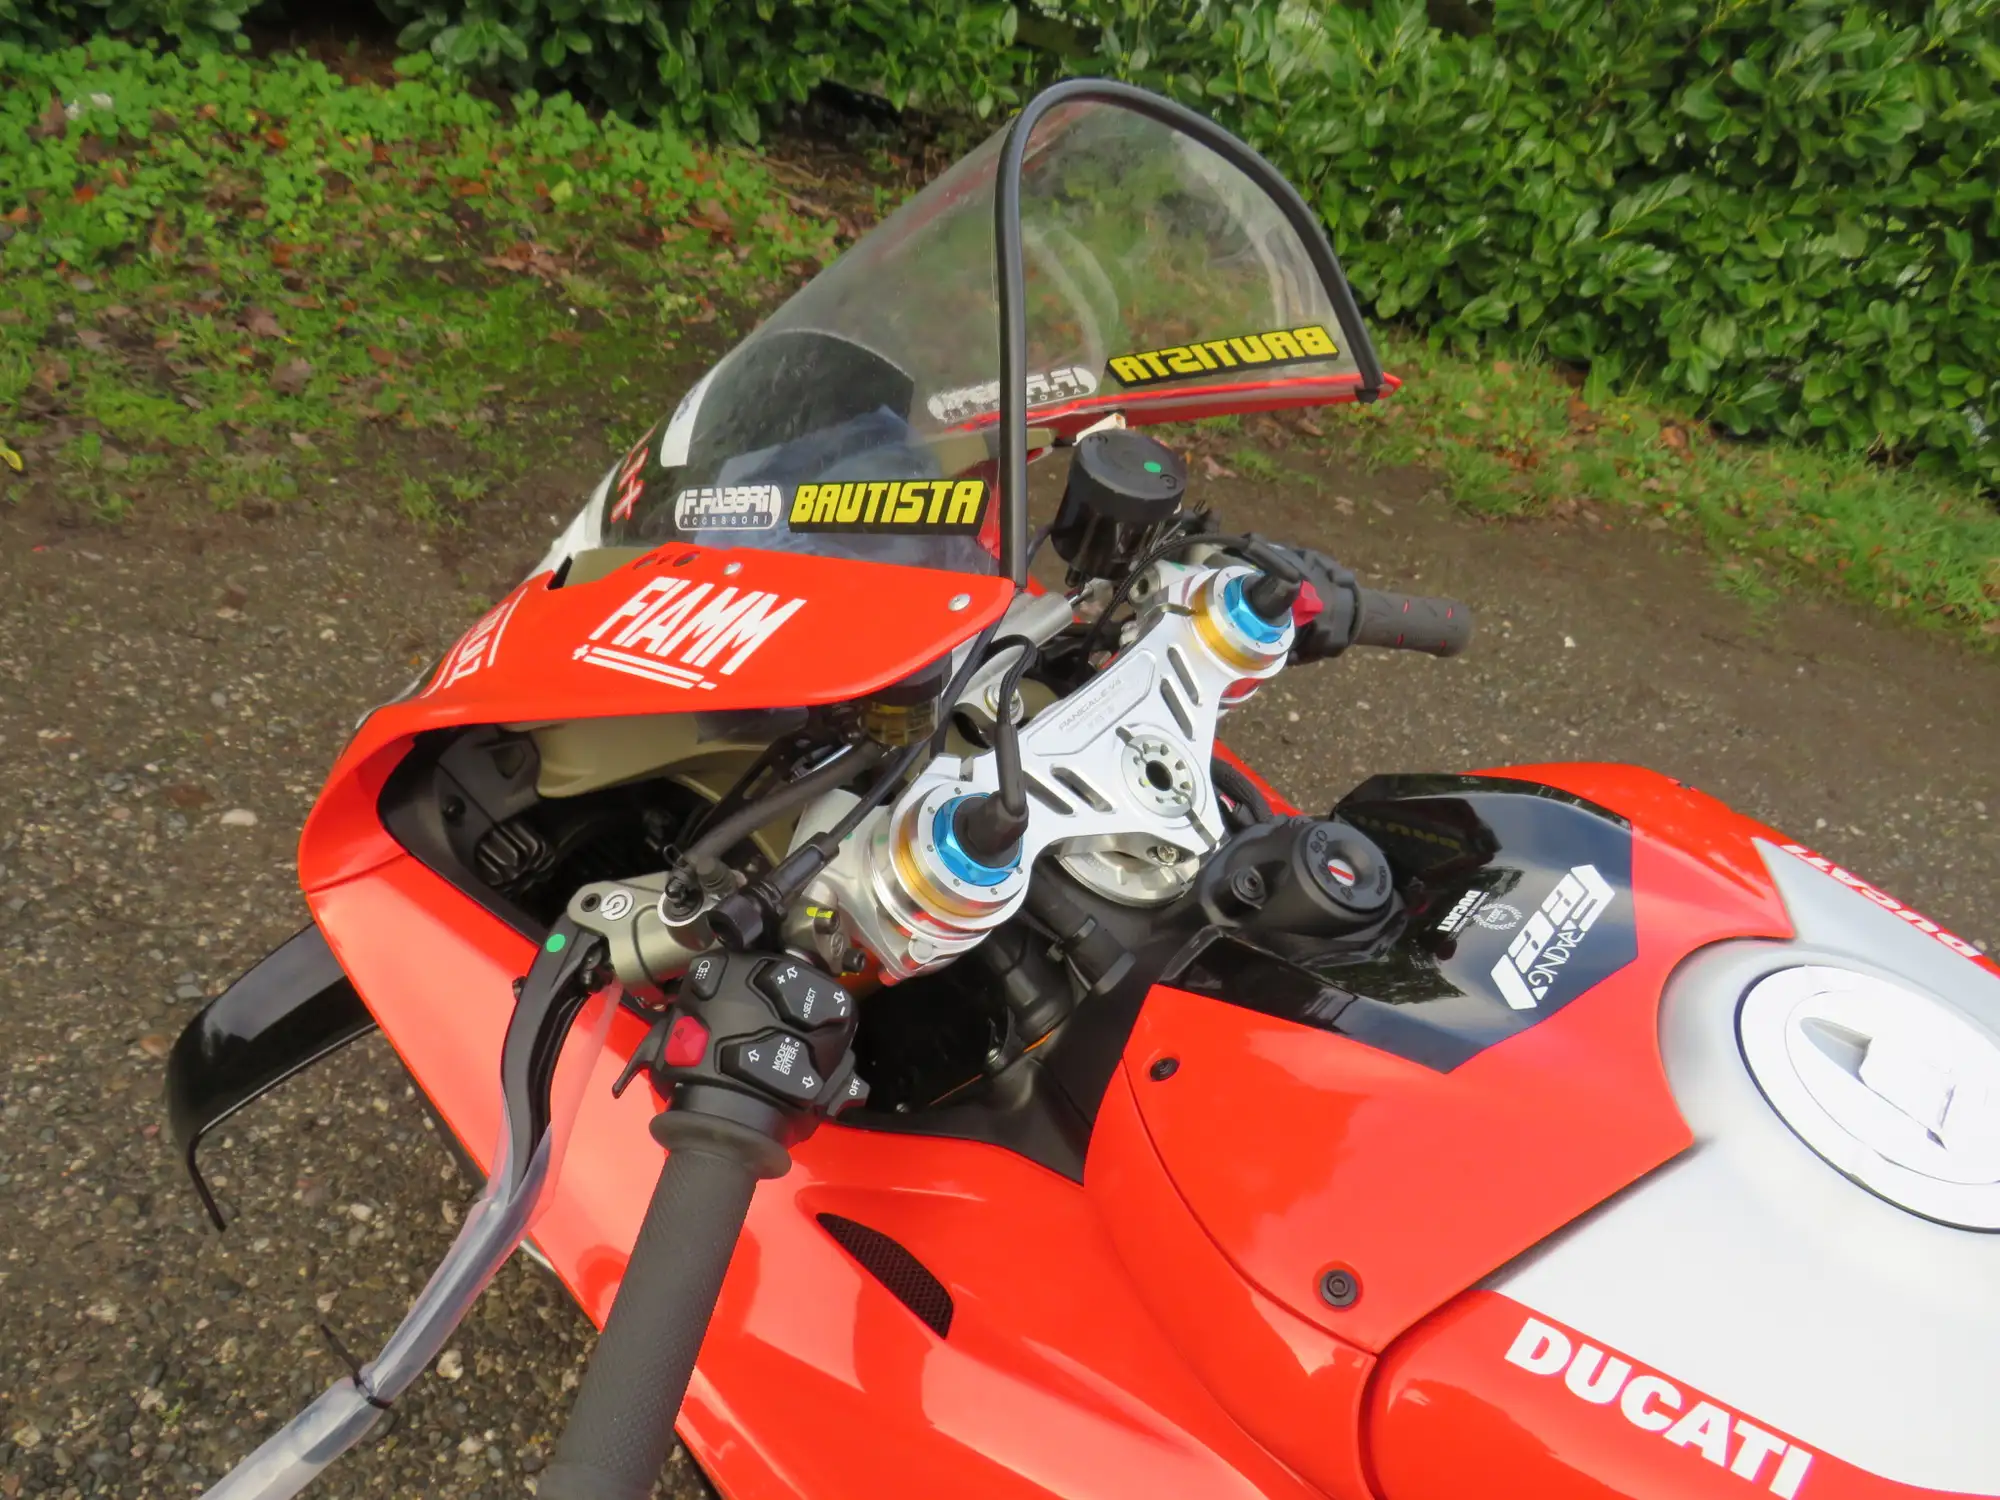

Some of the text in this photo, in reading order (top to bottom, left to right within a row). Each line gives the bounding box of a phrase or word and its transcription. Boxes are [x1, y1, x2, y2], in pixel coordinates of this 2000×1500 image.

[683, 515, 768, 525] ACCESSORI
[789, 481, 984, 524] BAUTISTA
[590, 576, 807, 675] FIAMM
[1437, 890, 1482, 932] DUCATI
[1779, 843, 1983, 958] DUCATI
[1527, 930, 1586, 986] RACING
[803, 987, 816, 1015] SELECT
[772, 1042, 789, 1071] MODE
[781, 1048, 799, 1076] ENTER
[848, 1078, 861, 1096] OFF
[1503, 1316, 1813, 1500] DUCATI
